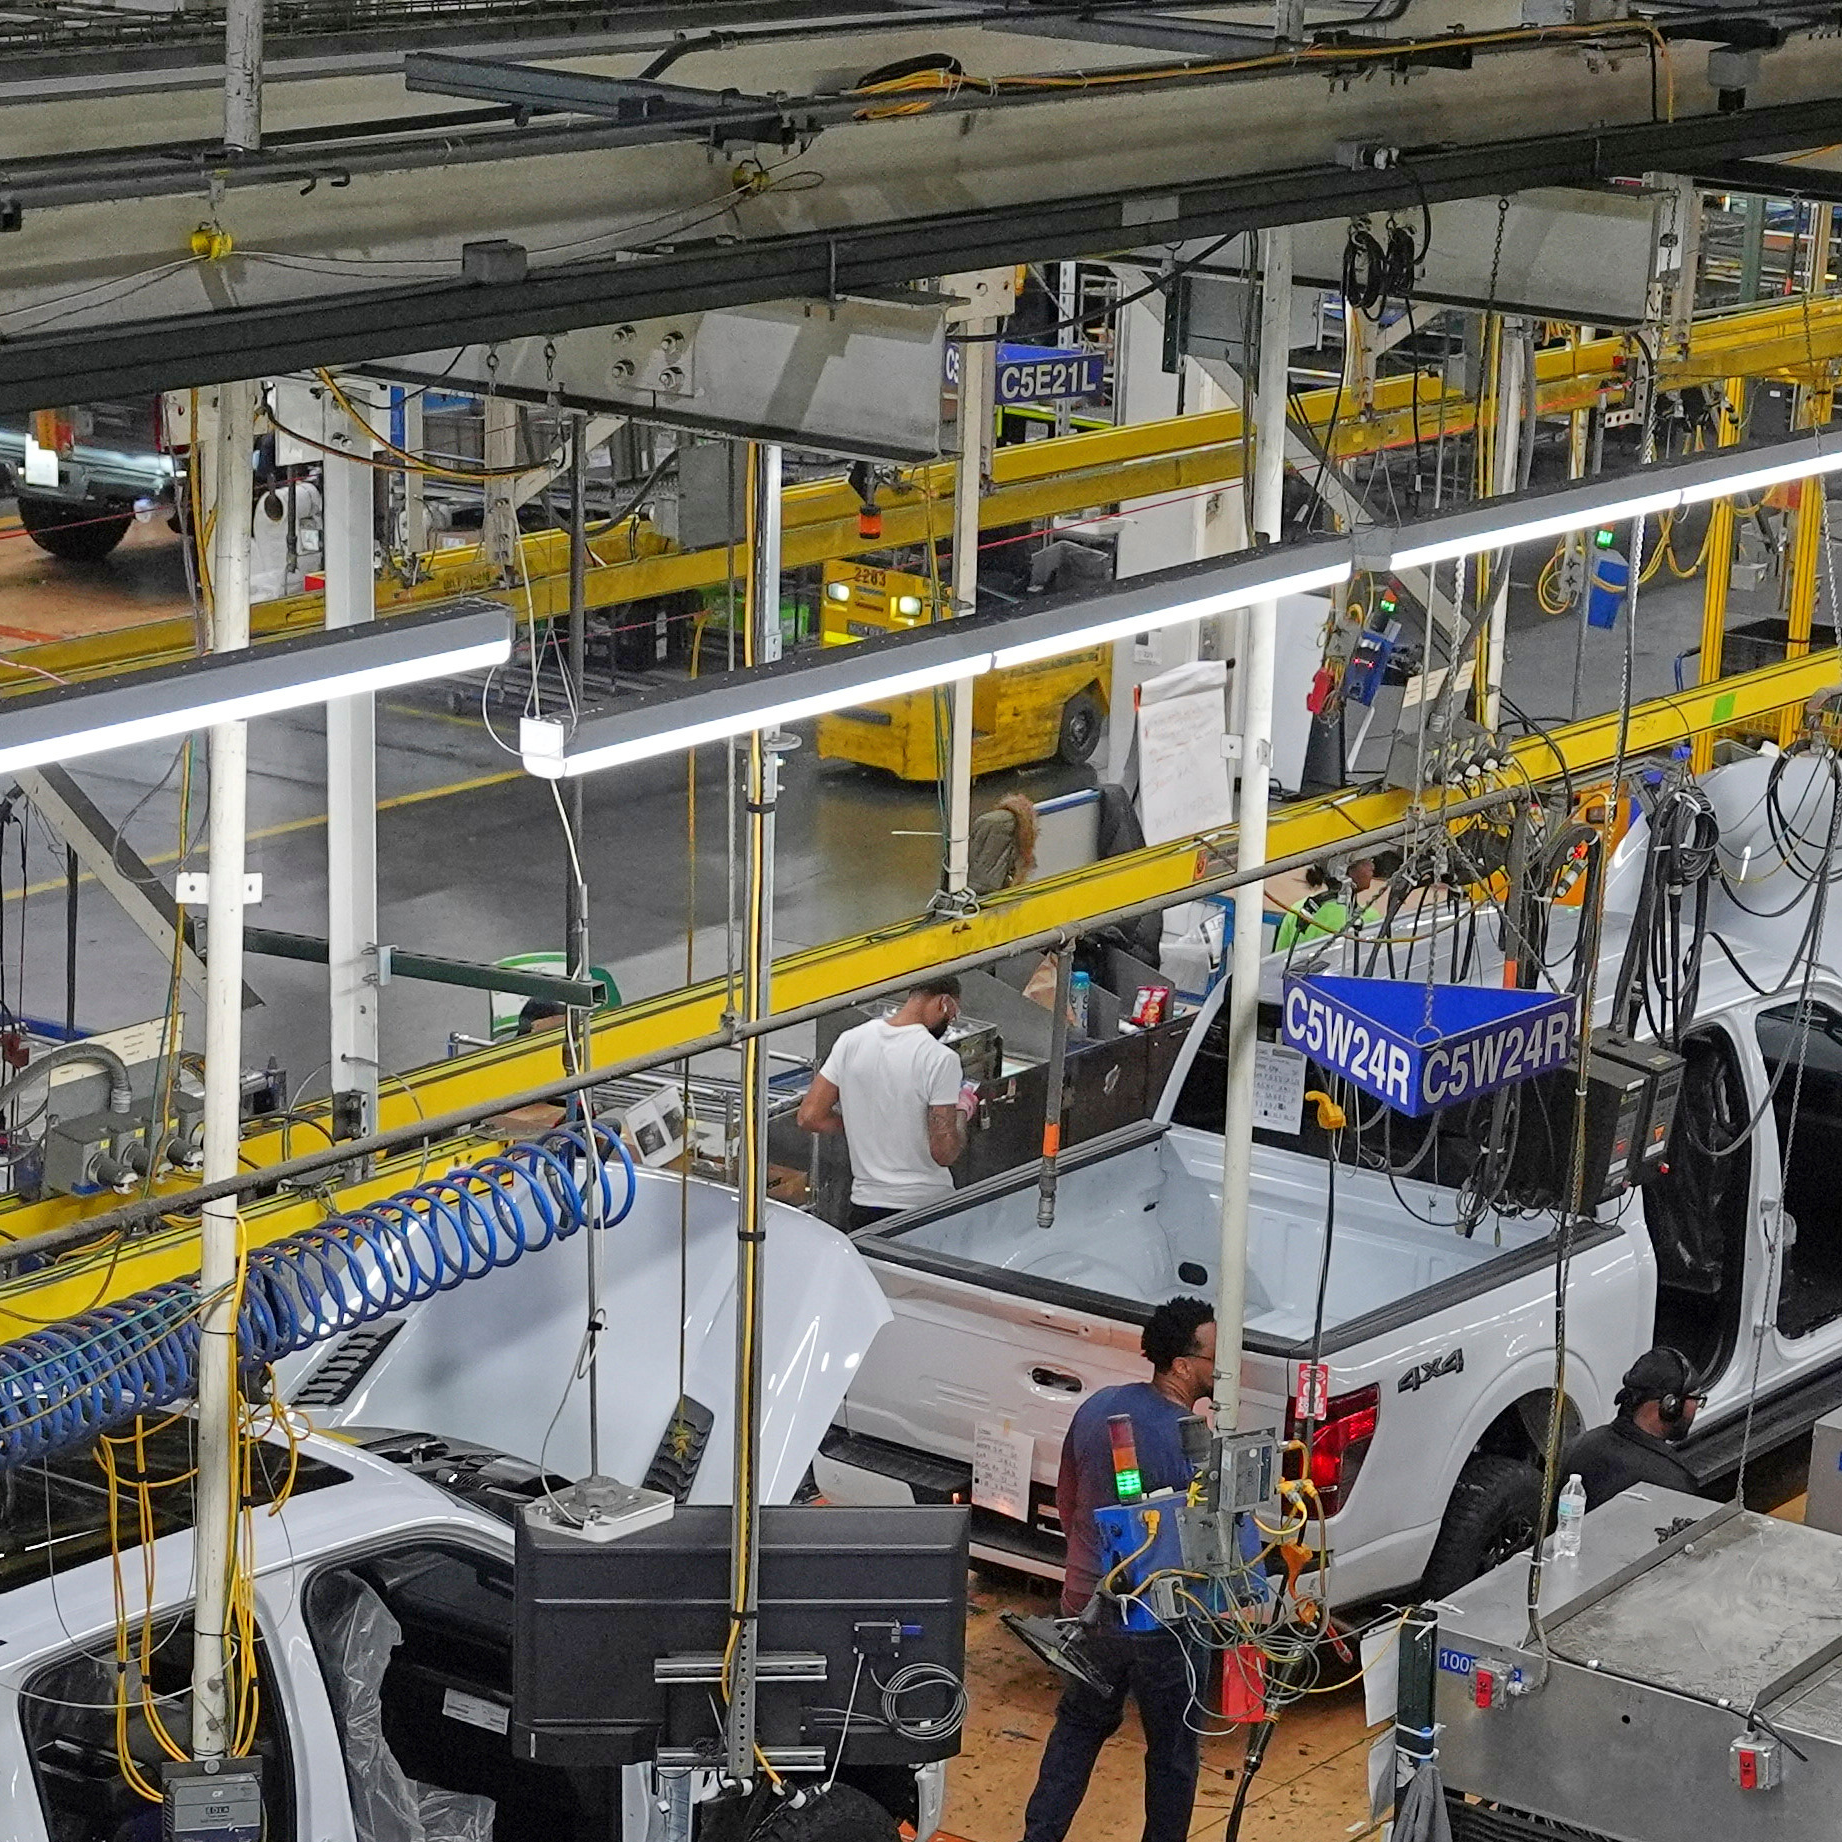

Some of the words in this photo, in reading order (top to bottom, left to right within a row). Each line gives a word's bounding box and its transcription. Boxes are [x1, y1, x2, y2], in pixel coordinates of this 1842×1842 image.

[1000, 360, 1097, 400] C5E21L
[1285, 986, 1411, 1106] C5W24R
[1422, 1010, 1570, 1104] C5W24R
